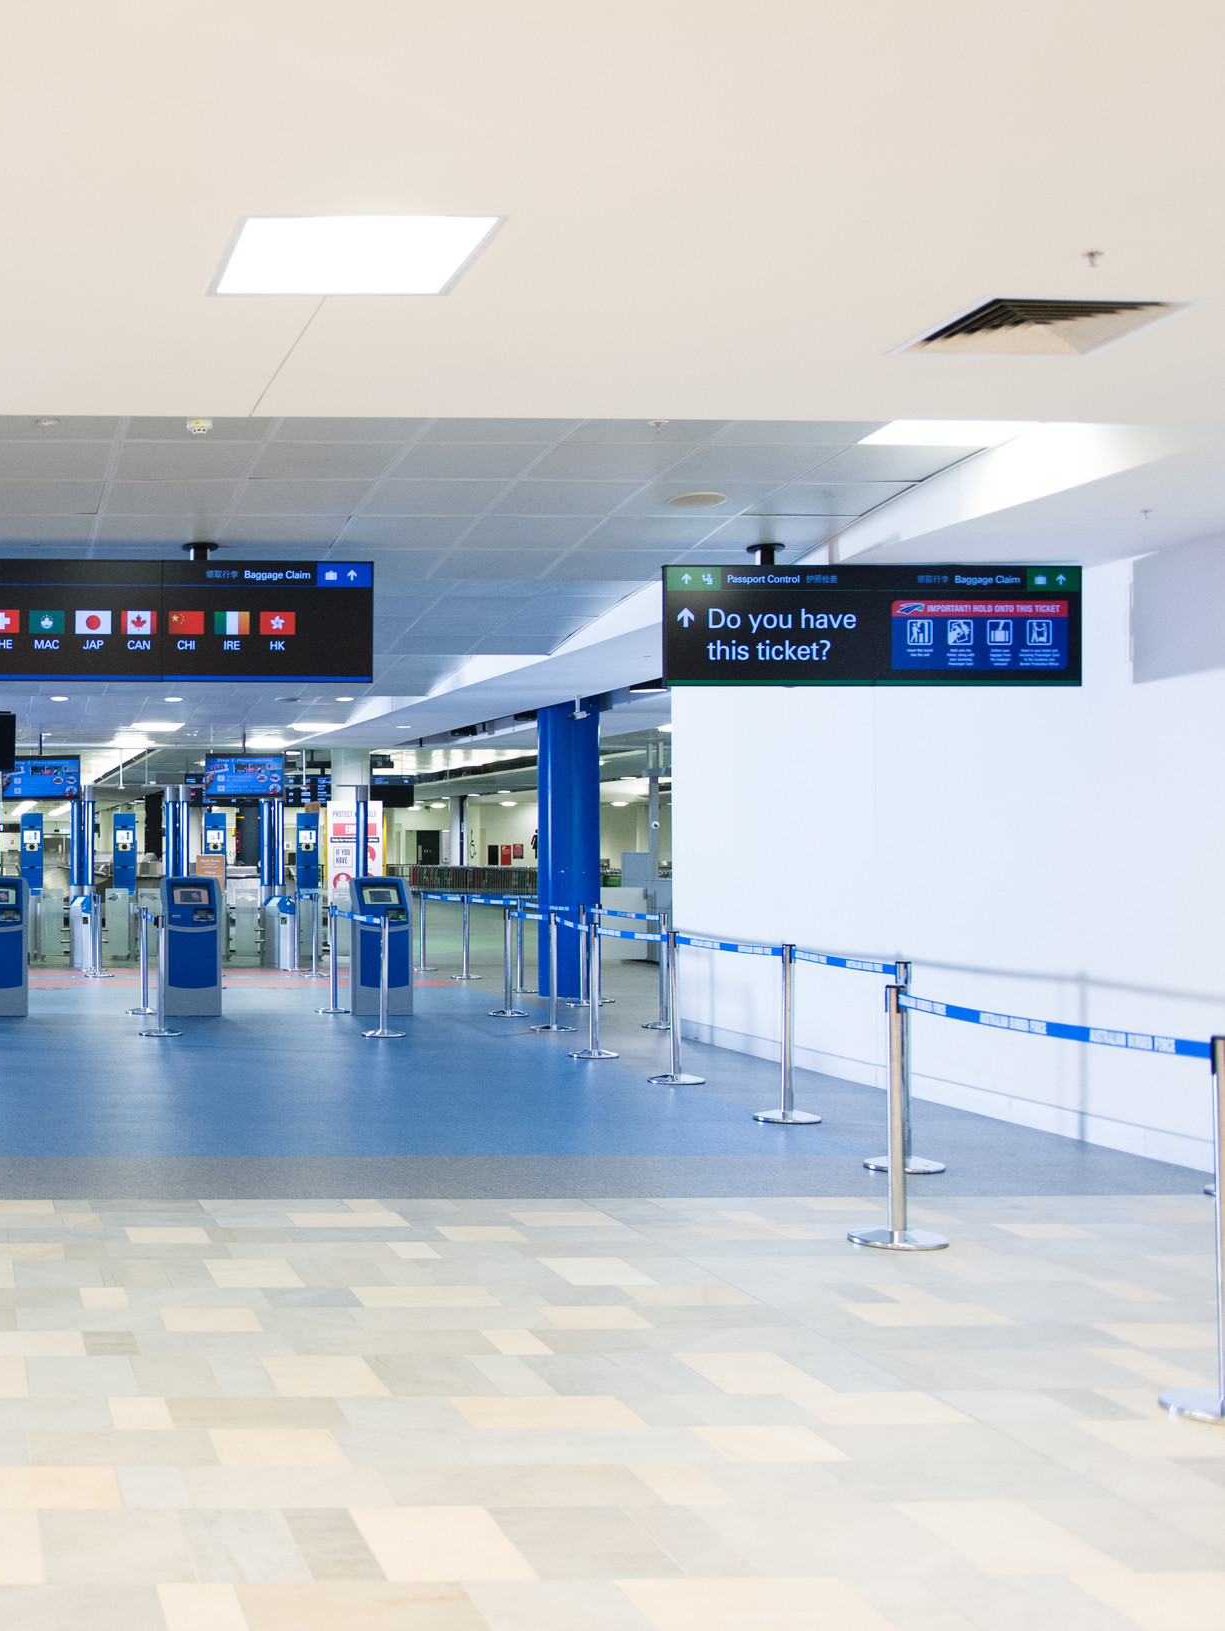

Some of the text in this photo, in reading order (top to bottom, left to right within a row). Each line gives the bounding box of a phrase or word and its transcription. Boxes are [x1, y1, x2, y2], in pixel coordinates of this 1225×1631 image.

[244, 570, 312, 581] Baggage Claim
[727, 574, 801, 585] Passport Control
[954, 575, 1021, 586] Baggage Claim
[927, 605, 1060, 613] IMPORTANT! HOLD ONTO THIS TICKET
[708, 608, 857, 634] Do you have
[34, 639, 60, 650] MAC
[83, 639, 104, 650] JAP
[127, 639, 151, 650] CAN
[177, 640, 196, 650] CHI
[223, 640, 241, 650] IRE
[269, 640, 286, 651] HK
[707, 640, 832, 661] this ticket?
[1089, 1028, 1176, 1054] AUSTRALIAN BORDER FORCE
